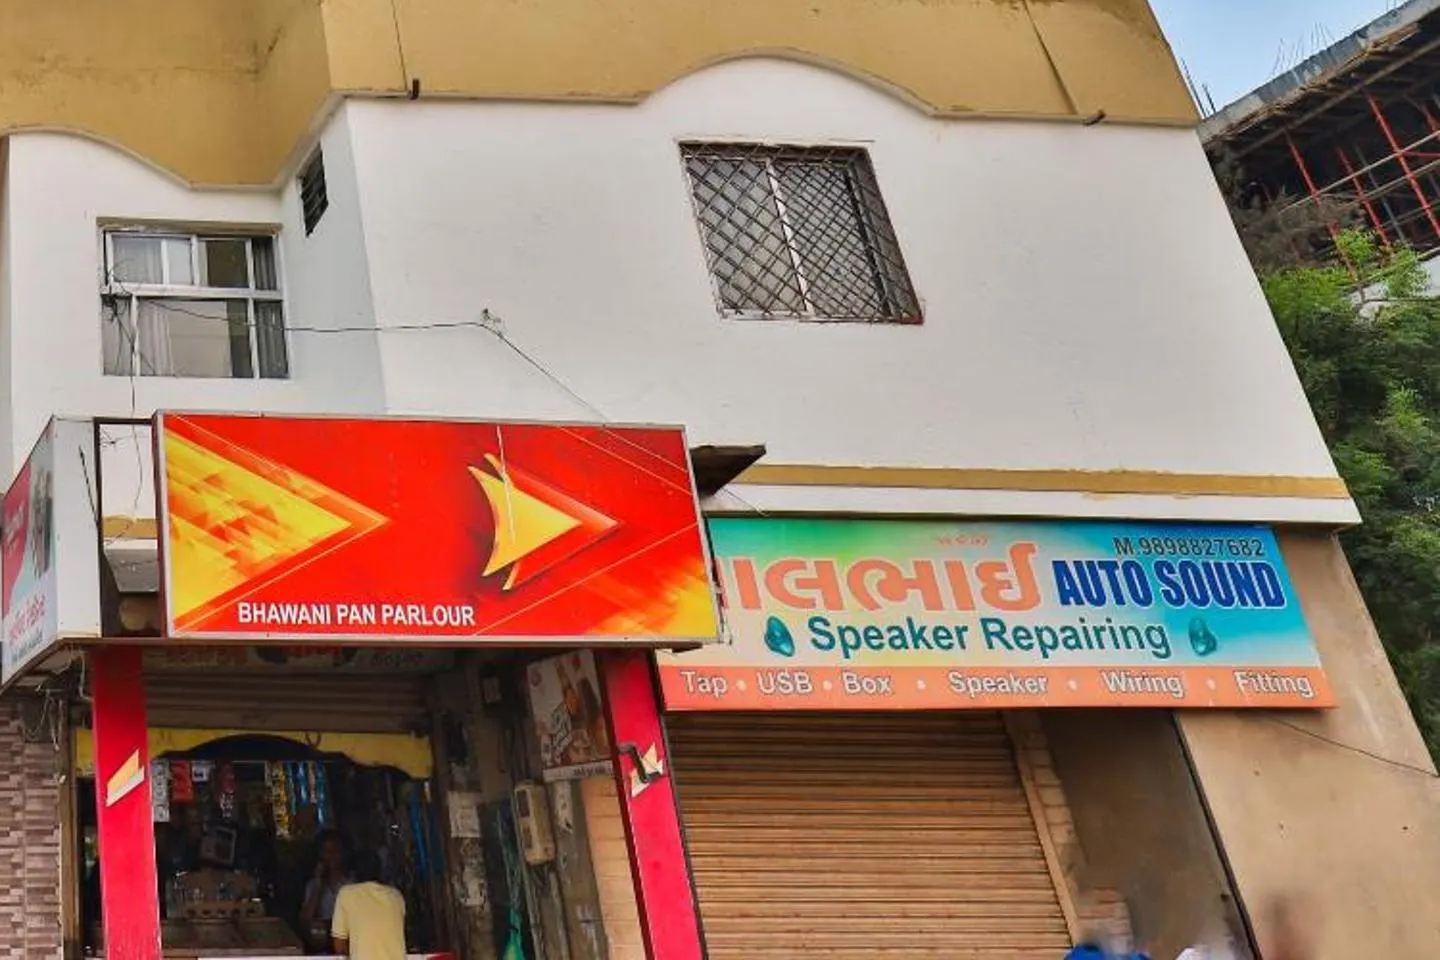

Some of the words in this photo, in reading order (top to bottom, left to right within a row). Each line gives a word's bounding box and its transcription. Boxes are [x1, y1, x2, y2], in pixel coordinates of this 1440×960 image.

[717, 542, 1042, 613] ાલભાઈ
[1050, 559, 1153, 608] AUTO
[1153, 559, 1288, 610] SOUND
[237, 601, 331, 625] BHAWANI
[336, 604, 377, 625] PAN
[381, 605, 476, 627] PARLOUR
[807, 615, 969, 659] Speaker
[980, 616, 1172, 659] Repairing
[680, 670, 728, 697] Tap
[756, 670, 814, 695] USB
[842, 671, 893, 695] Box
[947, 671, 1048, 699] Speaker
[1102, 669, 1186, 700] Wiring
[1233, 670, 1316, 700] Fitting
